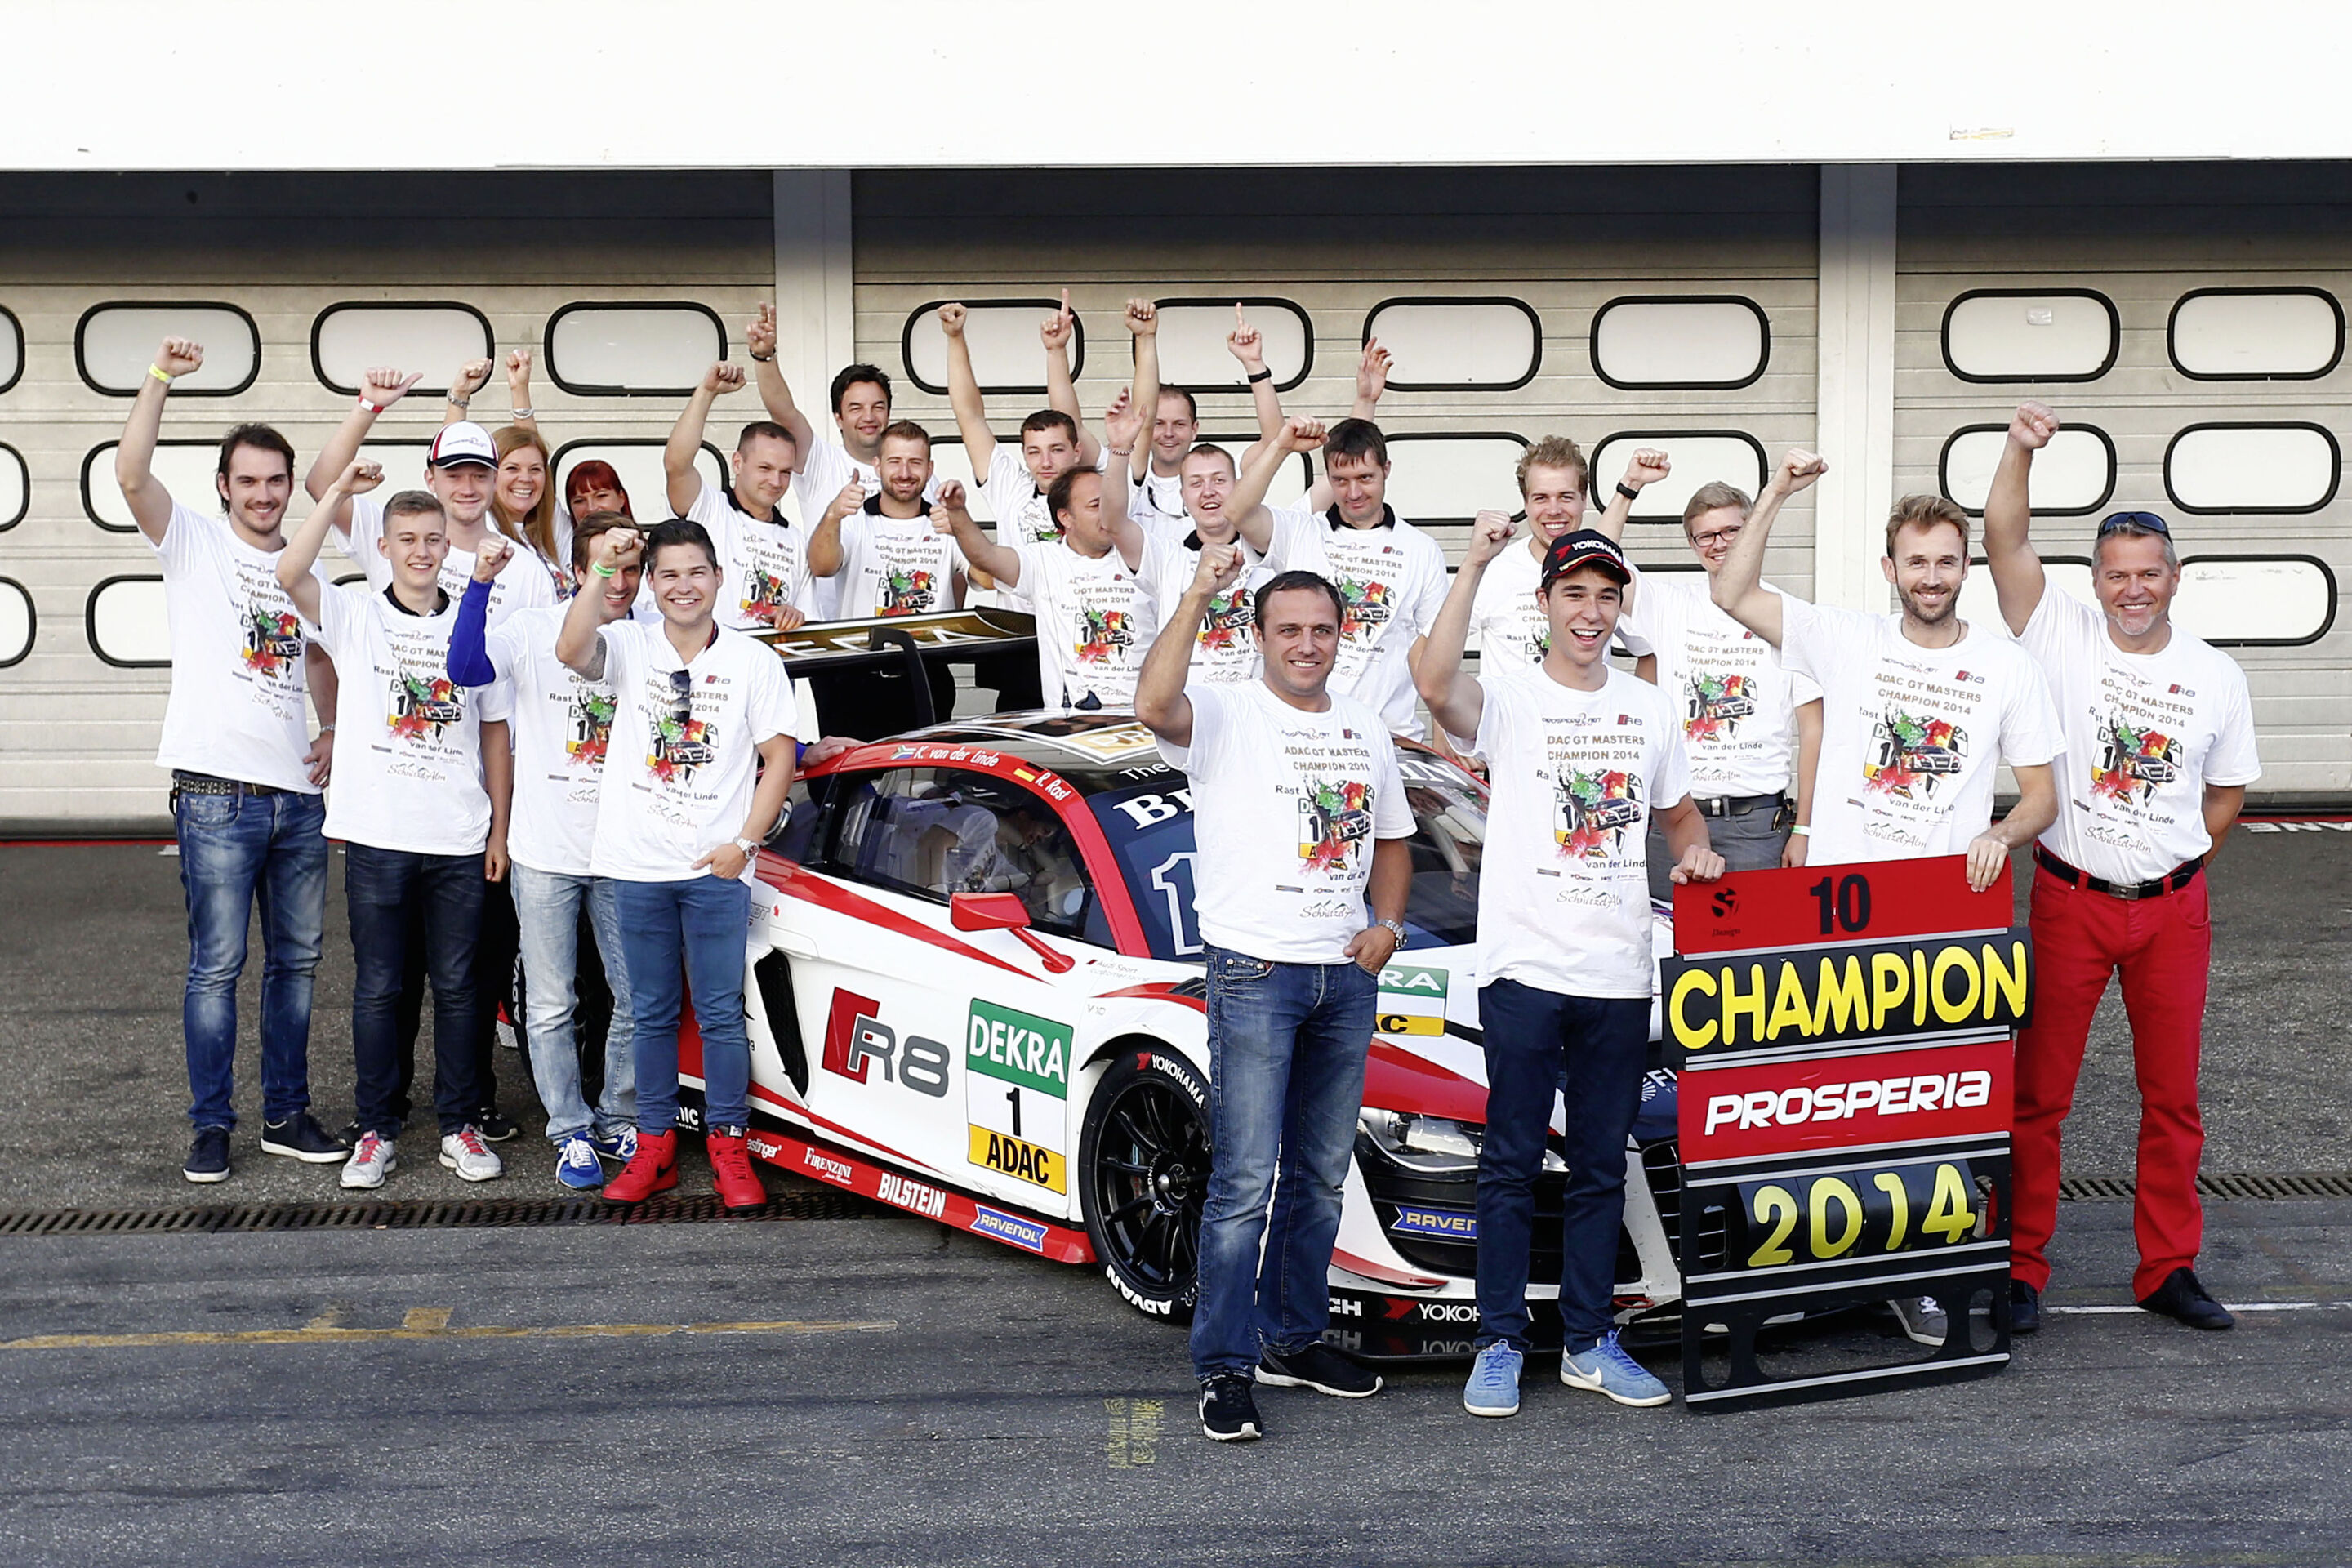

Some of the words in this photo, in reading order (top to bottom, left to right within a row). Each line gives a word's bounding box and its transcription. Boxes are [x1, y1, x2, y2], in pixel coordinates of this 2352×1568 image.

[772, 563, 790, 572] 2014
[1361, 557, 1403, 569] MASTERS
[1375, 569, 1396, 578] 2014
[1339, 642, 1354, 651] van
[1722, 647, 1764, 655] MASTERS
[1735, 658, 1756, 666] 2014
[373, 666, 395, 677] Rast
[1874, 672, 1904, 686] ADAC
[1908, 679, 1925, 690] GT
[1926, 684, 1982, 702] MASTERS
[549, 693, 572, 702] Rast
[690, 691, 729, 702] ASTERS
[1878, 688, 1940, 708] CHAMPION
[1943, 702, 1971, 715] 2014
[2126, 689, 2139, 699] GT
[2141, 696, 2194, 715] MASTERS
[695, 703, 719, 713] 2014
[2158, 714, 2185, 728] 2014
[1547, 736, 1570, 745] DAC
[1573, 736, 1588, 745] GT
[1592, 735, 1646, 745] MASTERS
[1721, 742, 1737, 751] der
[1740, 742, 1762, 751] Linde
[913, 745, 928, 760] K.
[949, 746, 971, 761] der
[970, 749, 1000, 768] Linde
[1284, 746, 1312, 755] ADAC
[1312, 748, 1325, 756] GT
[1328, 747, 1370, 758] MASTERS
[1548, 751, 1610, 760] CHAMPION
[1613, 751, 1640, 760] 2014
[1119, 763, 1170, 781] The
[1293, 761, 1347, 772] CHAMPION
[1035, 771, 1052, 787] R.
[1045, 778, 1071, 802] Rast
[1275, 784, 1300, 795] Rast
[1889, 798, 1910, 808] van
[1913, 802, 1931, 812] der
[2114, 802, 2132, 815] van
[2149, 813, 2175, 825] Linde
[1608, 859, 1621, 868] der
[1810, 874, 1871, 935] 10
[1097, 960, 1114, 969] Audi
[1116, 964, 1138, 973] Sport
[1668, 940, 2028, 1050] CHAMPION
[968, 1013, 1066, 1084] DEKRA
[848, 1015, 950, 1098] R8
[1152, 1054, 1205, 1109] YOKOHAMA
[1005, 1087, 1022, 1137] 1
[804, 1147, 853, 1178] FIRENZINI
[985, 1134, 1050, 1185] ADAC
[877, 1172, 947, 1218] BILSTEIN
[1748, 1163, 1976, 1267] 2014
[1106, 1264, 1173, 1315] ADVAN
